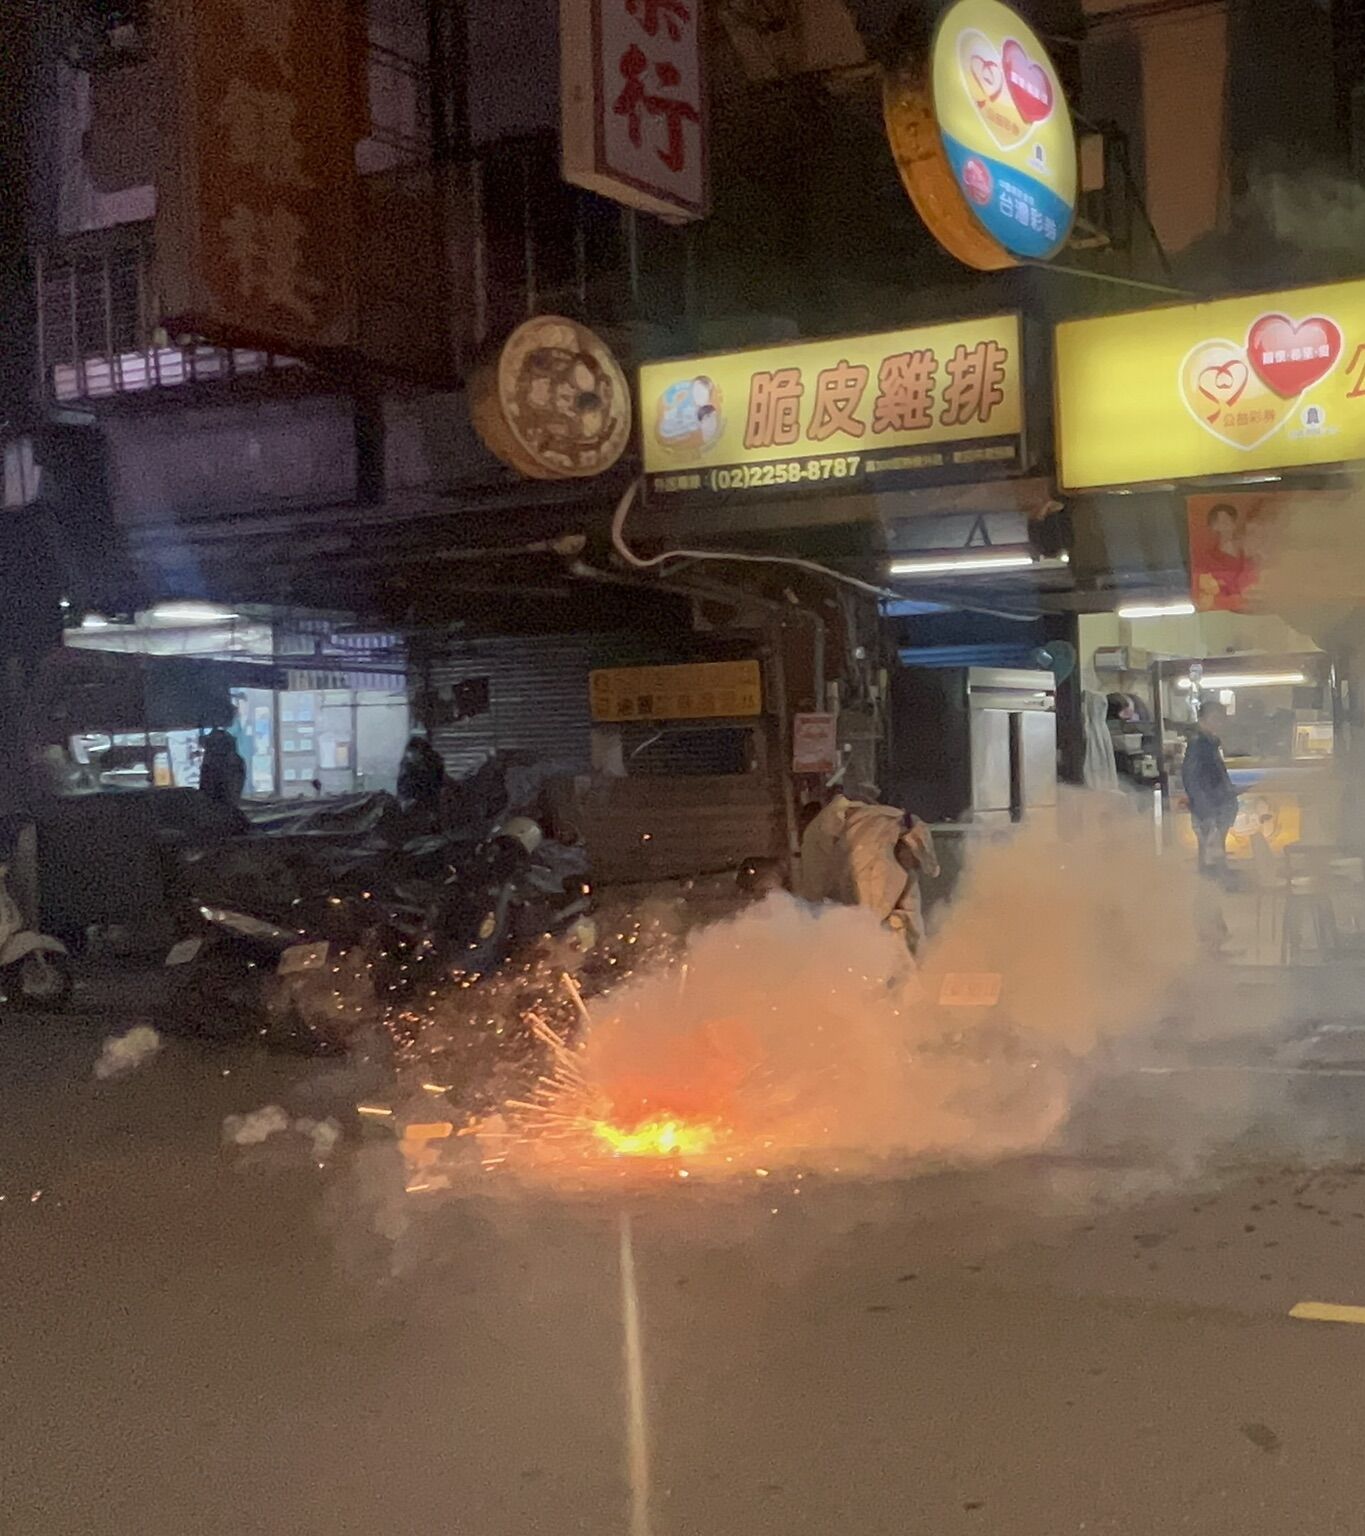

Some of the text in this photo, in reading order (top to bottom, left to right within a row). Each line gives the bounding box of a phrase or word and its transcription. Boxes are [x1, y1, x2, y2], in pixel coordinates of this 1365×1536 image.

[743, 340, 1008, 449] 脆皮雞排
[710, 456, 860, 493] (02)2258-8787
